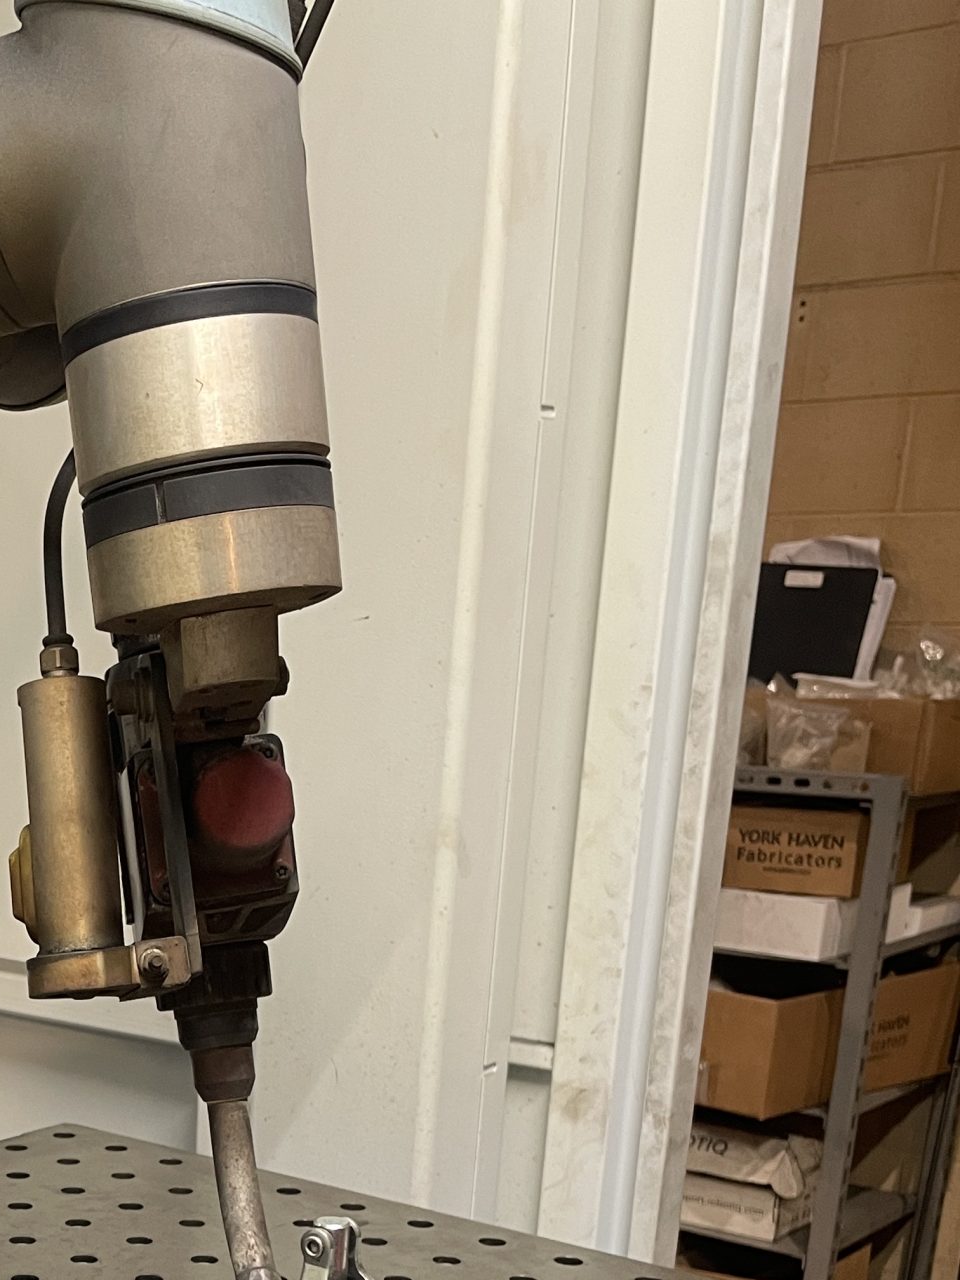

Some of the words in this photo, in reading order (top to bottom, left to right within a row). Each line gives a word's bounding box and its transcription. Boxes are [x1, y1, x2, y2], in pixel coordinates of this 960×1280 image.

[738, 827, 782, 846] YORK
[787, 831, 845, 850] HAVEN
[736, 846, 843, 869] Fabricators
